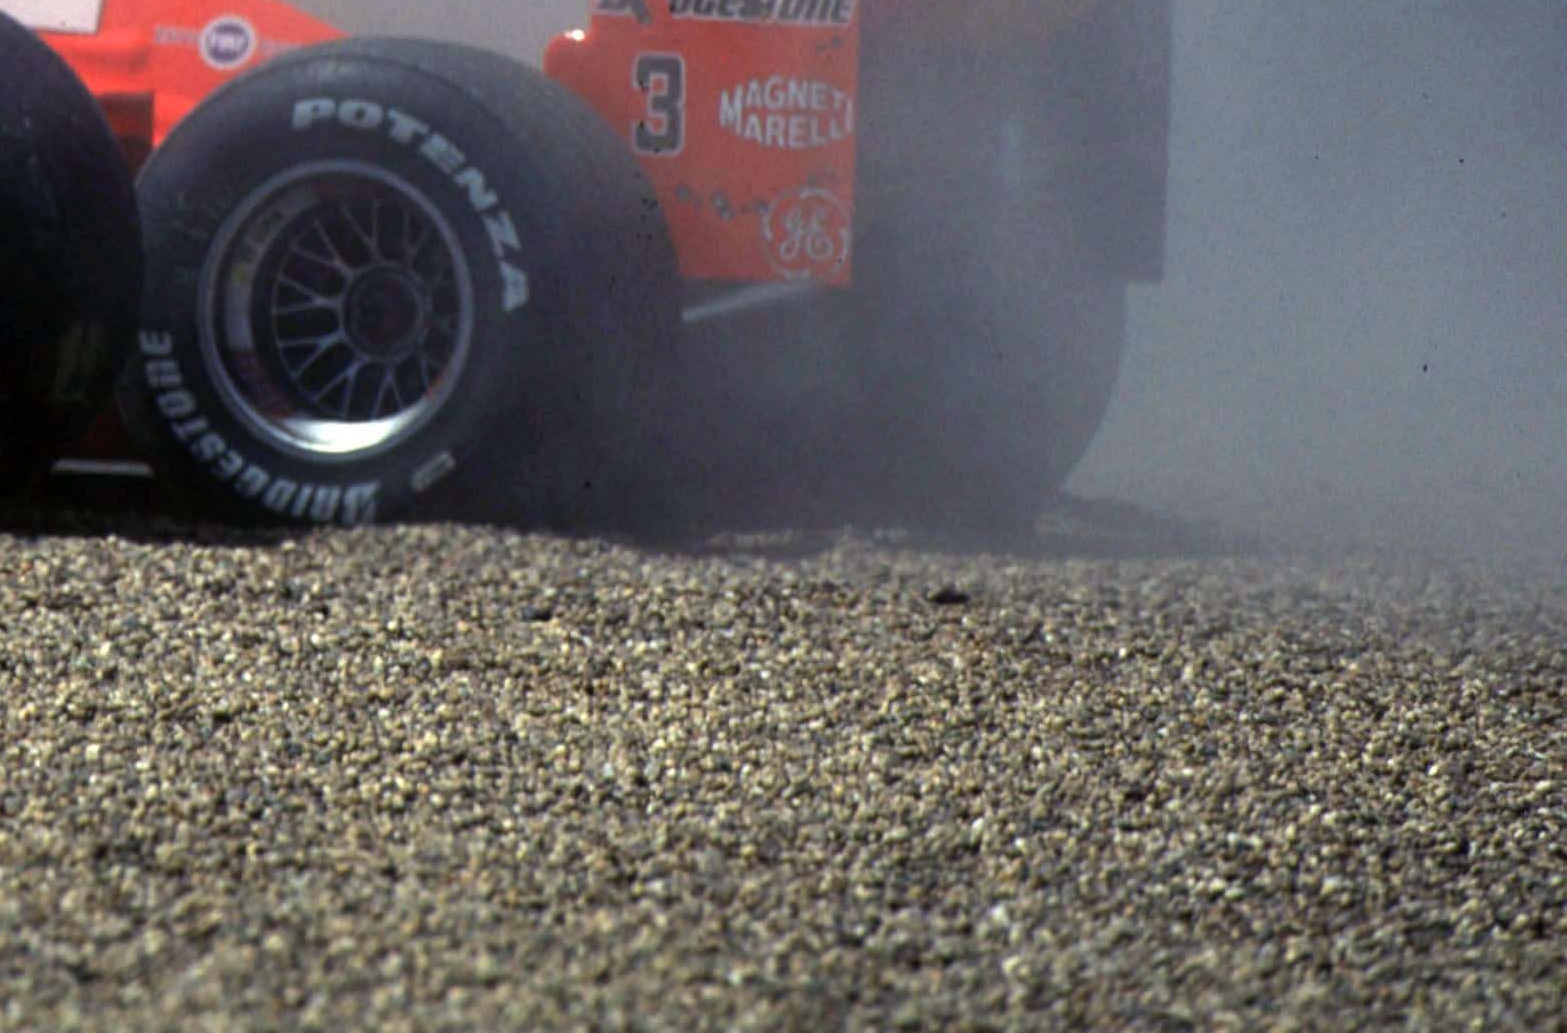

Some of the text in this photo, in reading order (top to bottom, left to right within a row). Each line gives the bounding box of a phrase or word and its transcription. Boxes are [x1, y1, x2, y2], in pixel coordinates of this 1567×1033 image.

[632, 52, 685, 155] 3
[719, 75, 854, 133] MAGNETI
[719, 92, 854, 150] MARELLI
[291, 97, 529, 313] POTENZA
[137, 328, 381, 524] BRIDGESTONE
